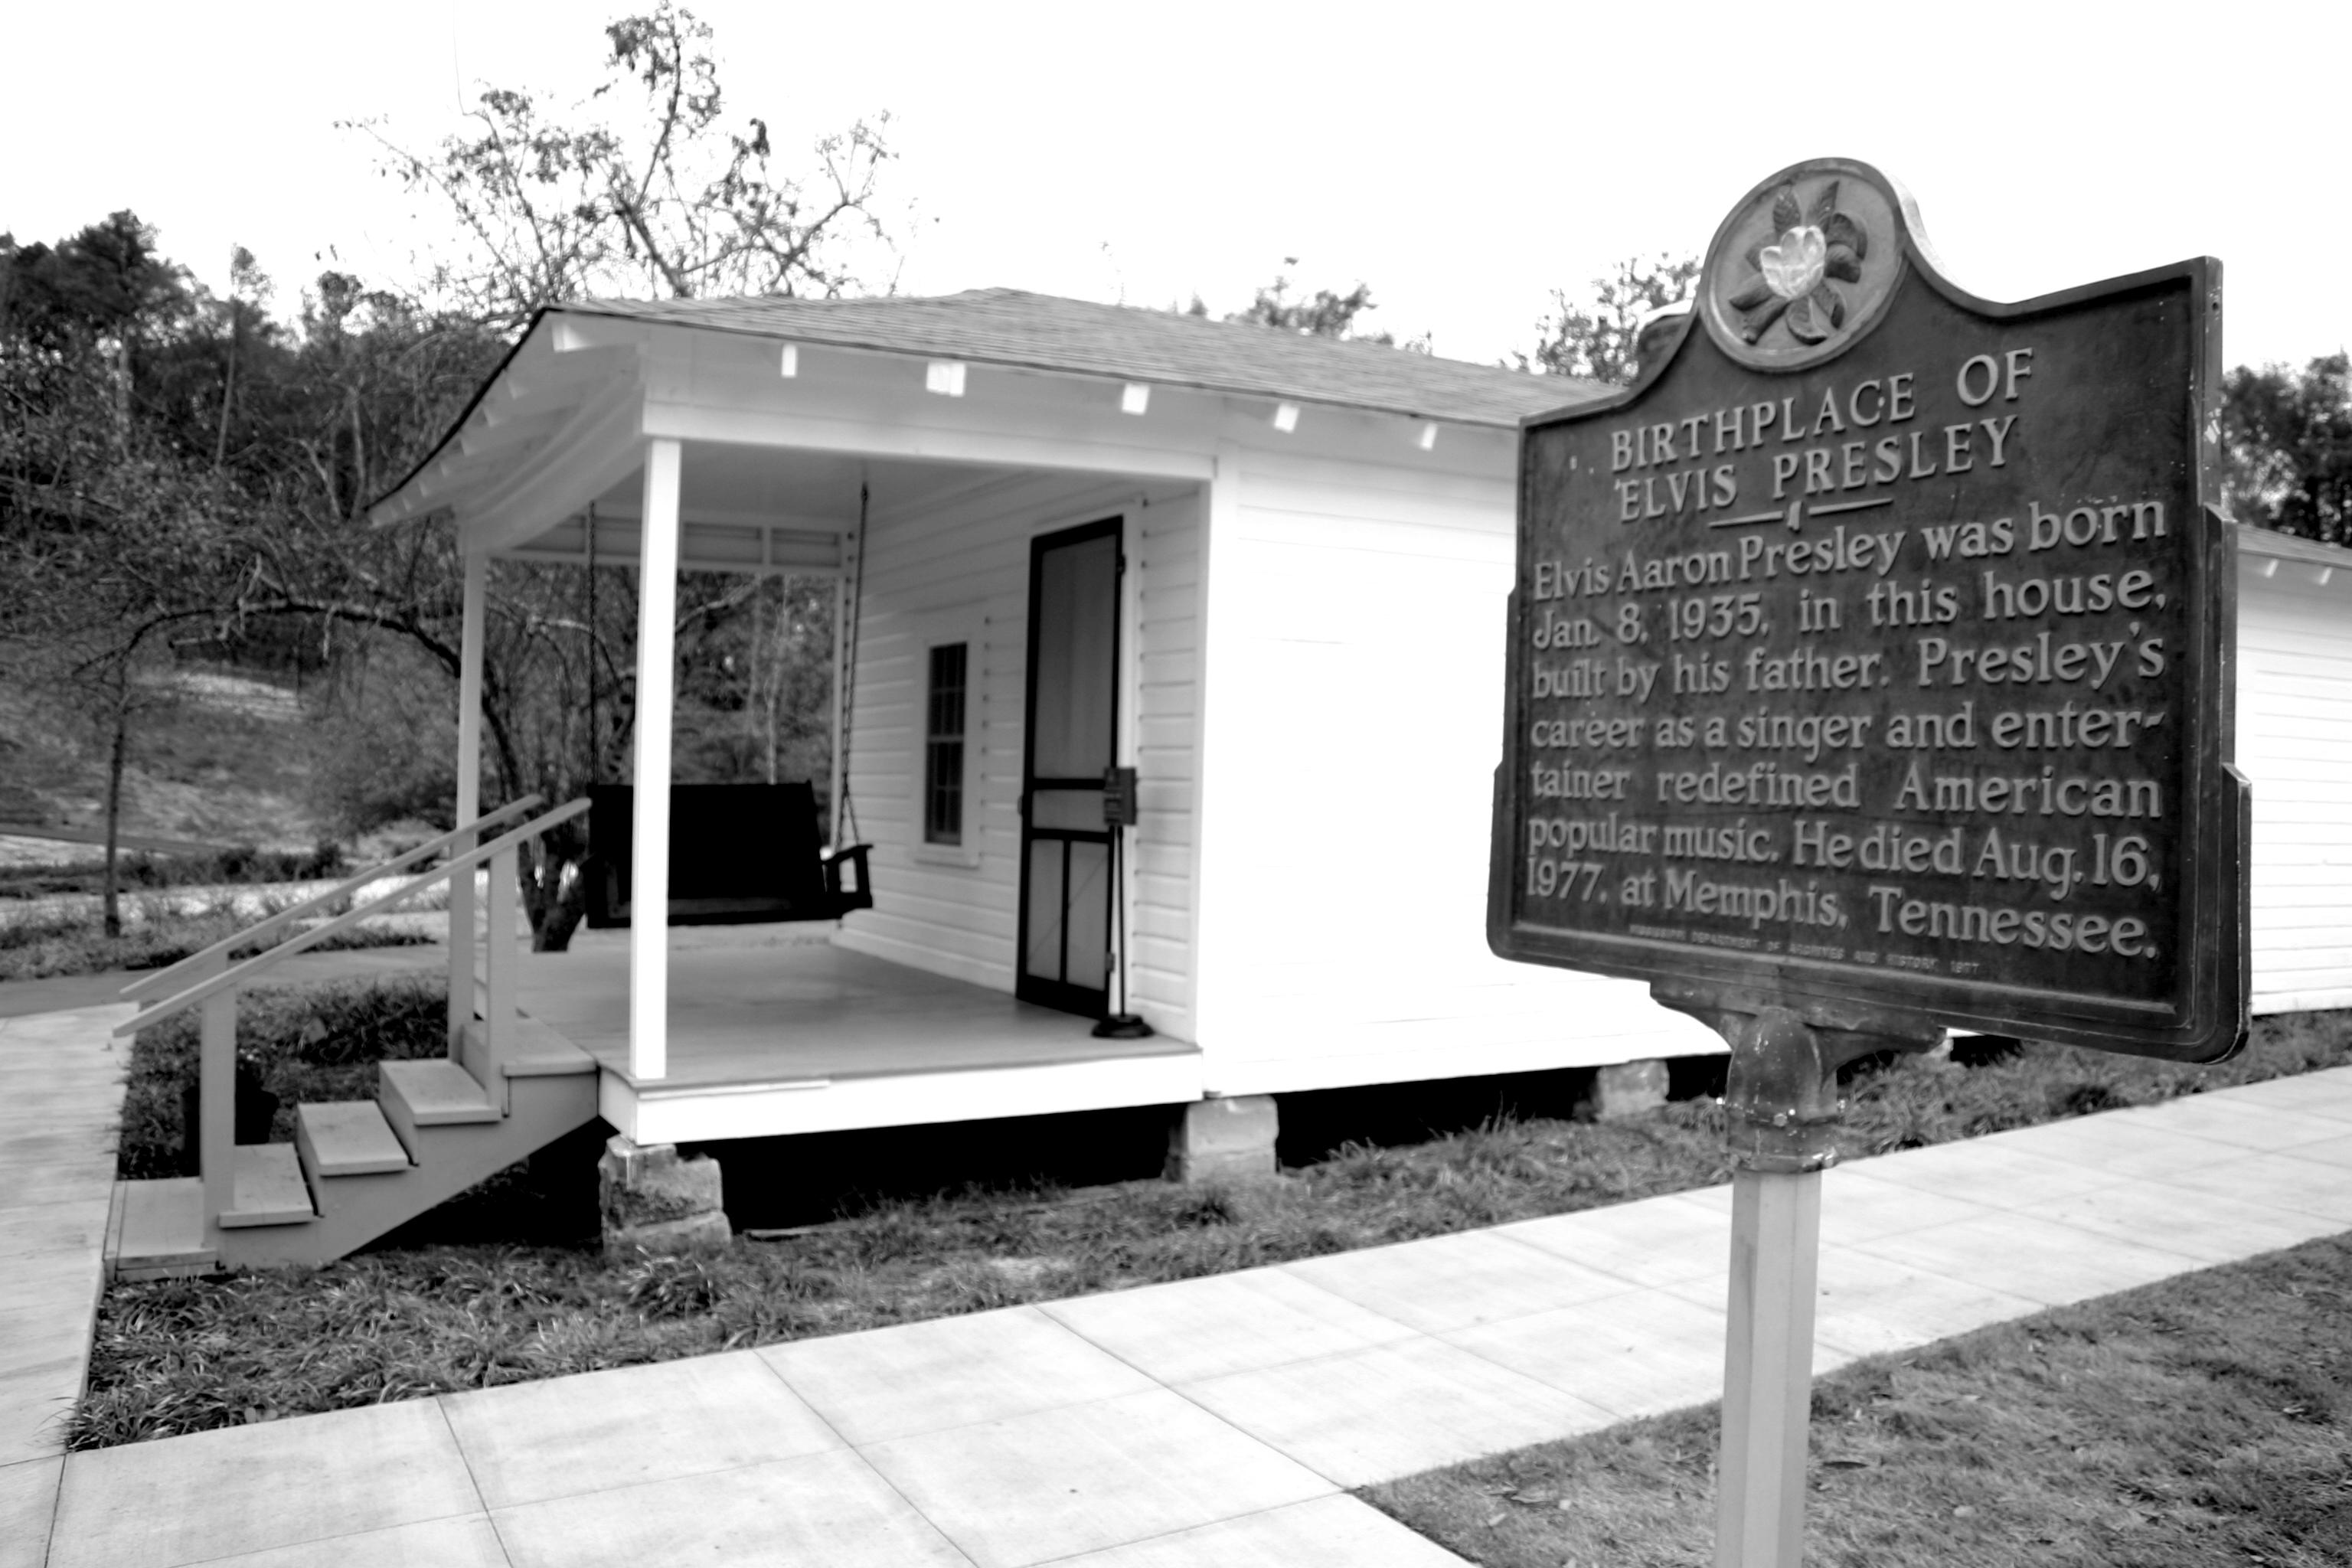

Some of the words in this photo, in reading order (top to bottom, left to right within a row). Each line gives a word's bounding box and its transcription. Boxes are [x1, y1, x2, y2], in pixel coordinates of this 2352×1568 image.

[1611, 373, 1915, 473] BIRTHPLACE
[1957, 348, 2034, 406] OF
[1619, 464, 1737, 523] ELVIS
[1773, 414, 2018, 501] PRESLEY
[1533, 557, 1609, 602] Elvis
[1617, 550, 1731, 593] Aaron
[1739, 525, 1906, 581] Presley
[1921, 517, 2014, 561] was
[2029, 501, 2167, 552] born
[1533, 610, 1600, 650] Jan.
[1669, 592, 1769, 641] 1935,
[1799, 589, 1841, 634] in
[1867, 578, 1958, 627] this
[1984, 568, 2167, 620] house,
[1533, 658, 1606, 699] built
[1617, 655, 1661, 704] by
[1674, 652, 1731, 694] his
[1745, 646, 1890, 692] father.
[1918, 621, 2166, 690] Presley's
[1531, 715, 1645, 750] career
[1655, 716, 1695, 750] as
[1704, 717, 1728, 750] a
[1736, 706, 1871, 763] singer
[1886, 701, 1977, 750] and
[1991, 701, 2165, 750] enter-
[1531, 760, 1632, 800] tainer
[1656, 762, 1861, 808] redefined
[1893, 762, 2164, 818] American
[1528, 812, 1659, 858] popular
[1664, 816, 1780, 864] music.
[1792, 819, 1854, 868] He
[1859, 825, 1964, 875] died
[1972, 827, 2084, 901] Aug.
[2093, 832, 2161, 892] 16,
[1620, 869, 1656, 907] at
[1664, 868, 1850, 930] Memphis,
[1868, 884, 2158, 959] Tennessee.
